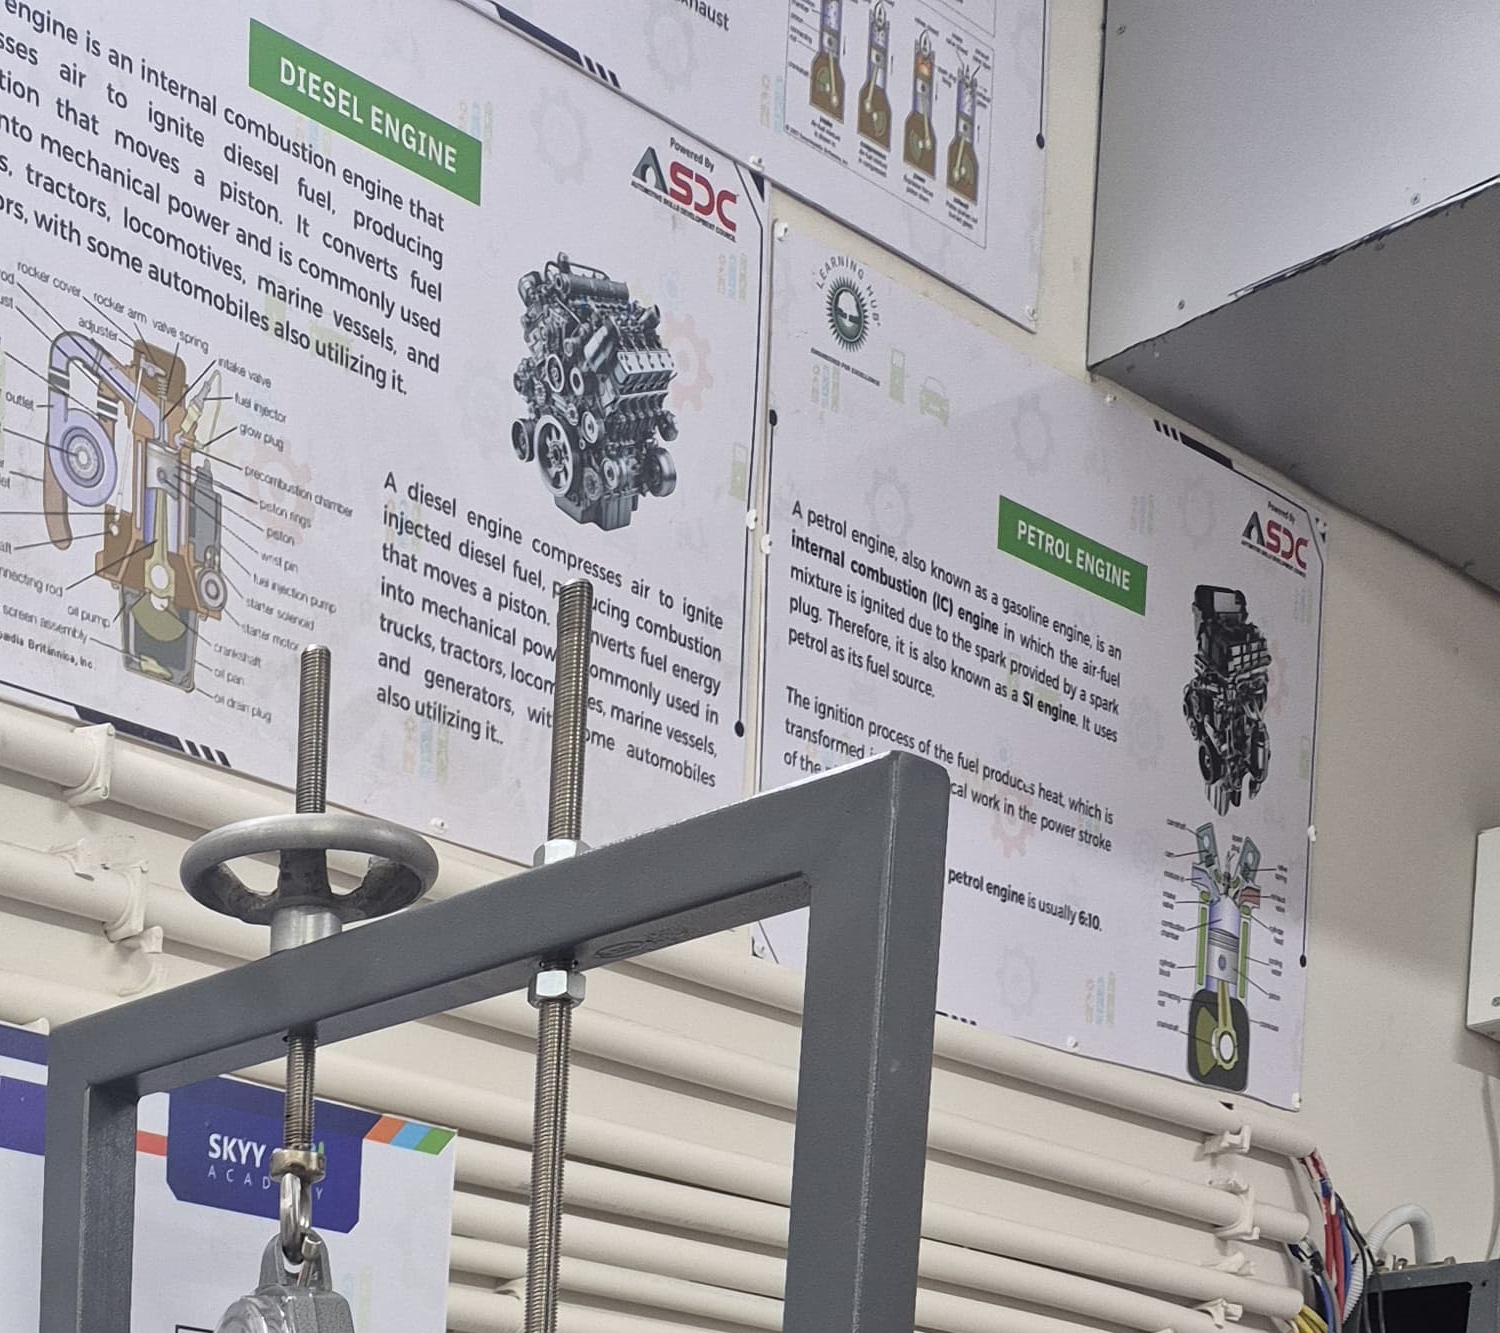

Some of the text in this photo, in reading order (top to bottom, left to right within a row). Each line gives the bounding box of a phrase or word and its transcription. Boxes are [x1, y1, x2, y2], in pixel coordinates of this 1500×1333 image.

[5, 0, 444, 232] engine is an internal combustion engine that
[281, 56, 456, 173] DIESEL ENGINE
[60, 63, 86, 88] air
[107, 83, 127, 109] to
[149, 101, 204, 148] ignite
[224, 143, 278, 185] diesel
[298, 177, 335, 215] fuel,
[354, 209, 443, 271] producing
[18, 261, 81, 297] rocker cover
[34, 210, 80, 247] with
[87, 235, 142, 274] some
[148, 263, 269, 332] automobiles
[274, 320, 310, 350] also
[316, 339, 386, 390] utilizing
[392, 369, 406, 396] it.
[816, 256, 865, 290] LEARNING
[240, 423, 284, 453] glow plug
[384, 472, 723, 630] A diesel engine compresses air to ignite
[792, 500, 1121, 661] A petrol engine, also known as a gasoline engine, is an
[1018, 520, 1130, 591] PETROL ENGINE
[46, 583, 63, 598] rod
[792, 528, 1120, 687] internal combustion (IC) engine in which the air-fuel
[948, 868, 983, 892] petrol
[986, 882, 1025, 906] engine
[1028, 892, 1036, 909] is
[1039, 900, 1076, 926] usually
[208, 1133, 267, 1168] SKYY
[208, 1165, 323, 1200] ACADY
